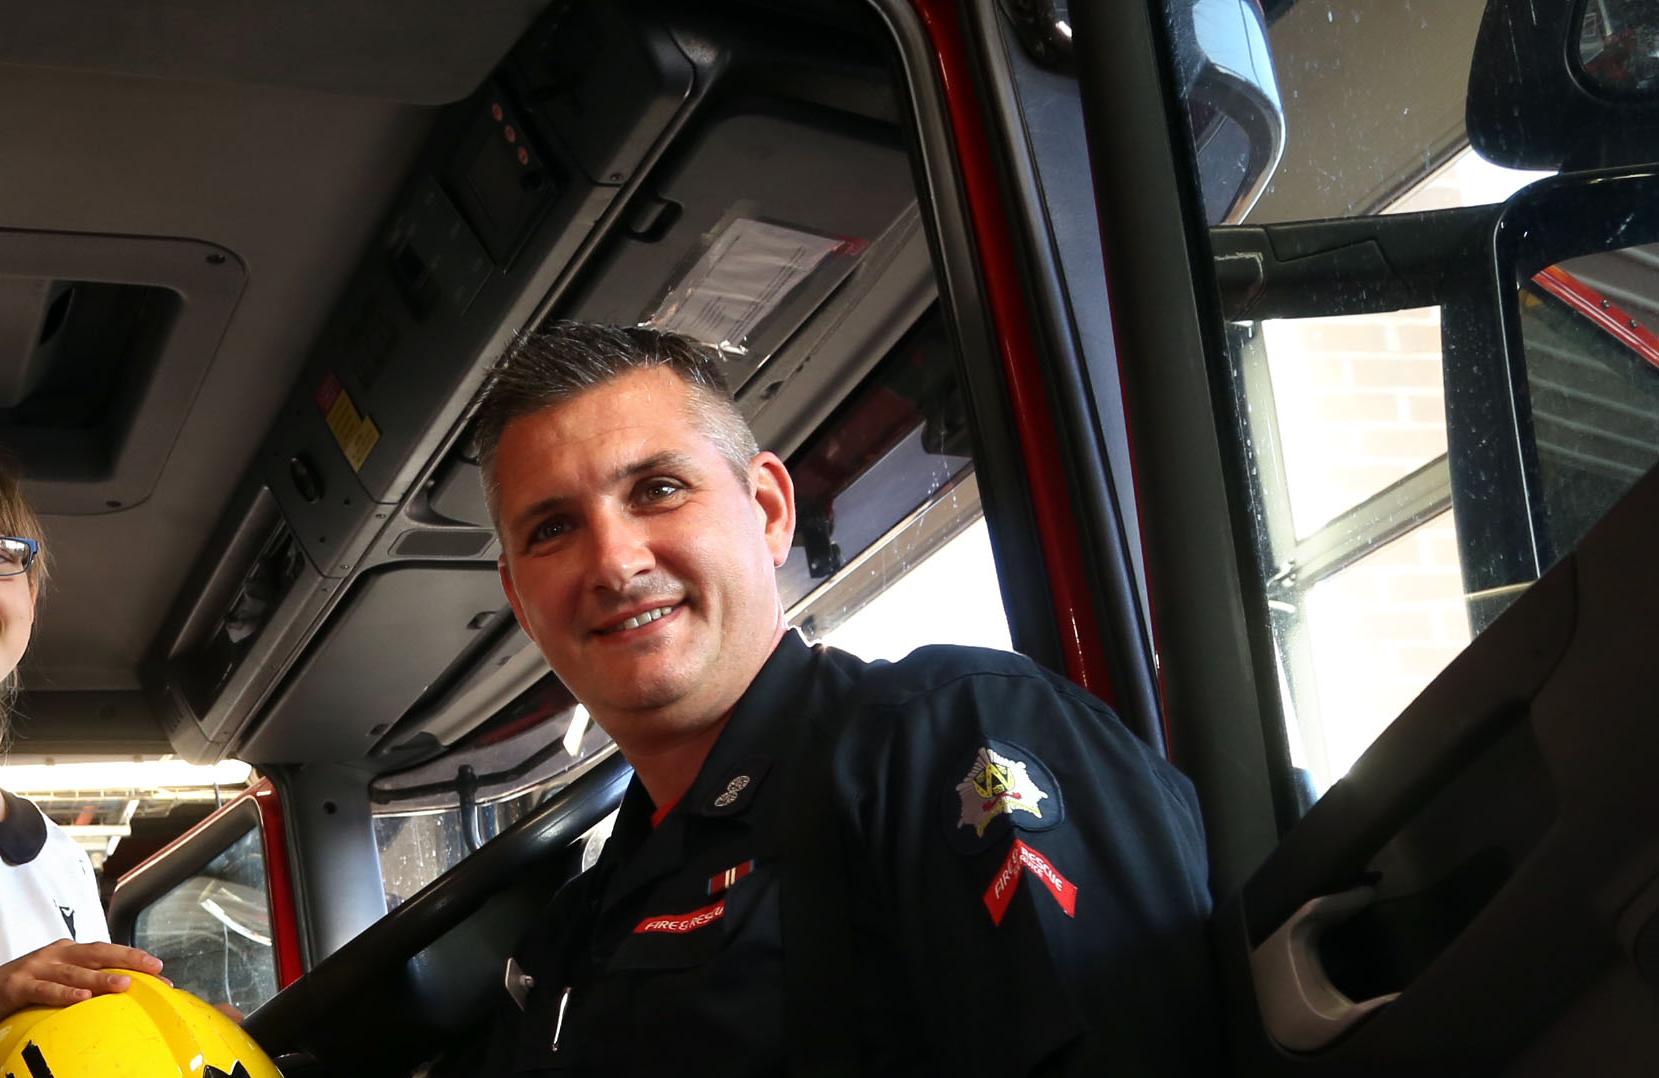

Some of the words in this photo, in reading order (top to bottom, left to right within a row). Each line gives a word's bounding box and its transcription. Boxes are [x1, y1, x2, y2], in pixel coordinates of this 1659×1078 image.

[995, 859, 1013, 899] FIRE
[1020, 846, 1063, 892] RESCUE
[645, 920, 678, 931] FIRE
[689, 906, 725, 929] RESCU
